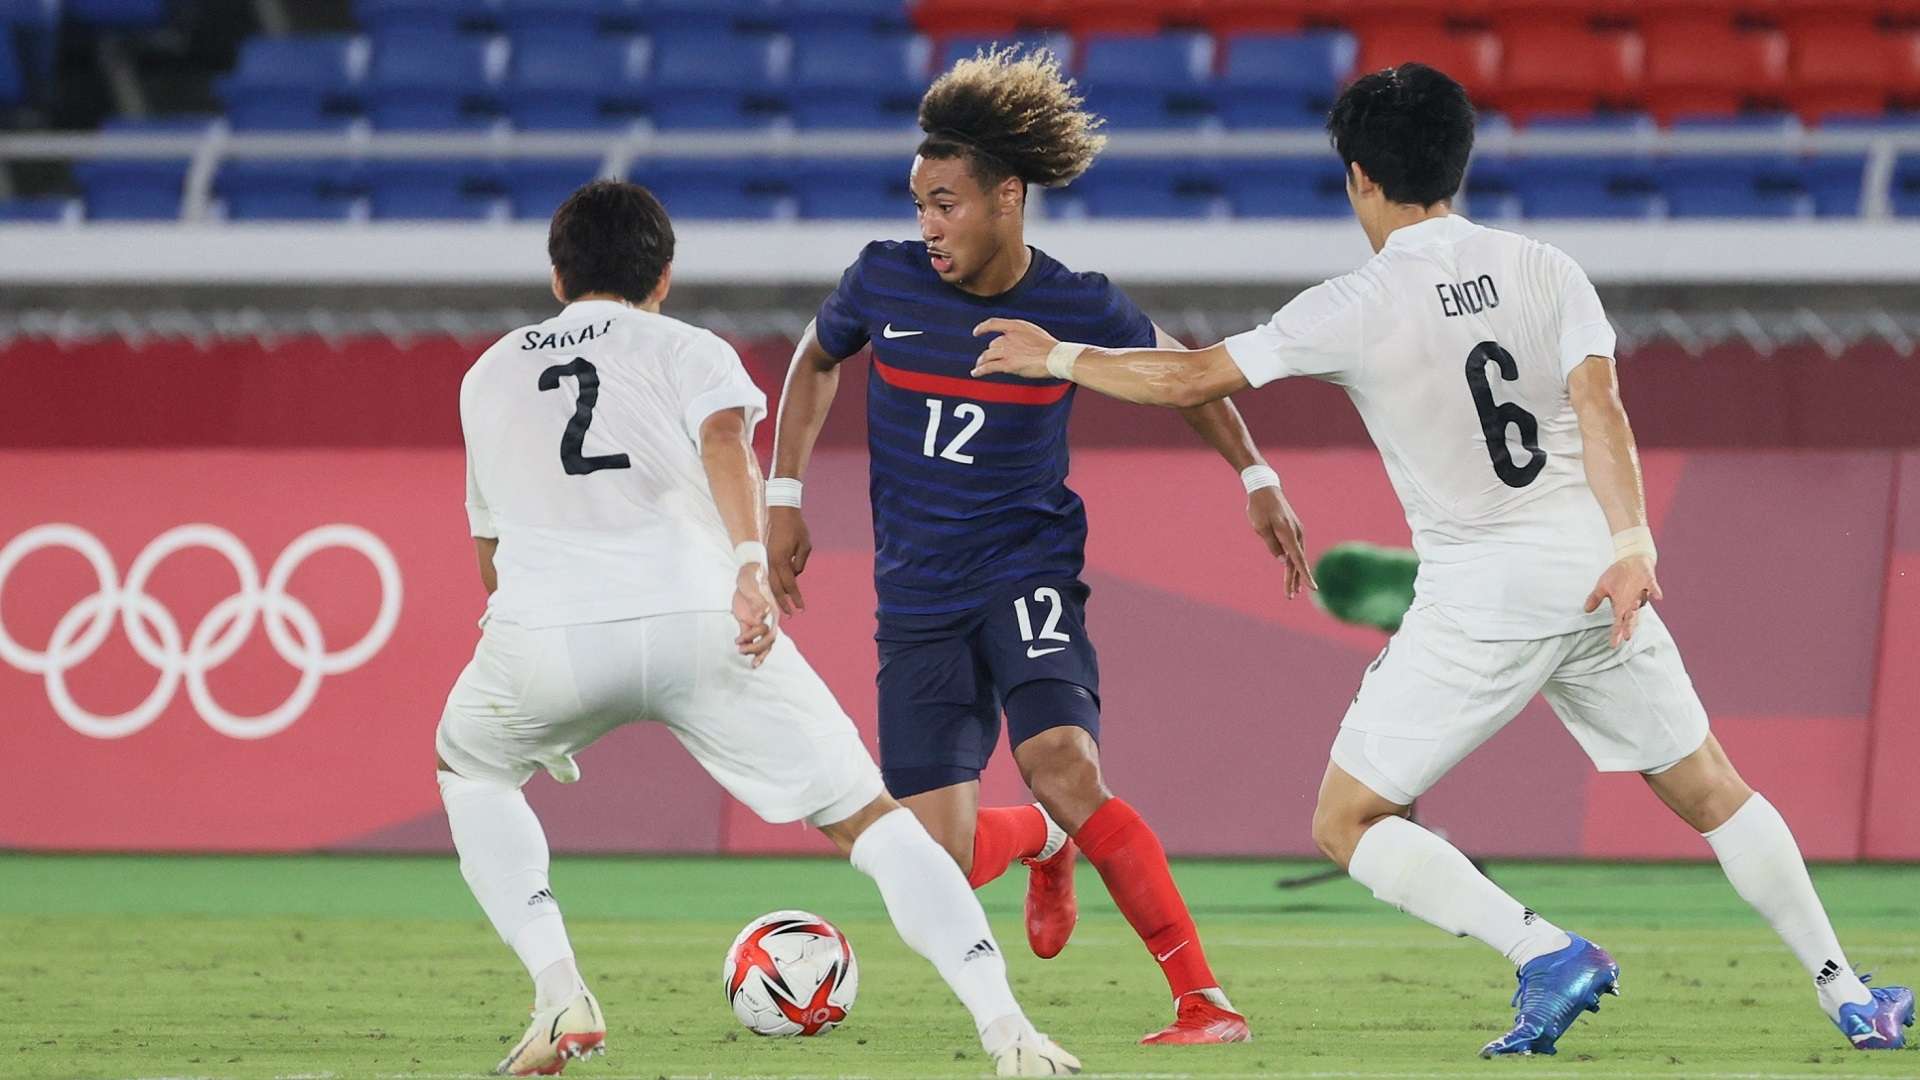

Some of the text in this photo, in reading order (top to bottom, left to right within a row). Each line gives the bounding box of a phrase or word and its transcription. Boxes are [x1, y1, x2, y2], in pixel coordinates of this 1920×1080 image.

[1435, 274, 1499, 317] ENDO
[538, 357, 631, 475] 2
[923, 398, 986, 464] 12
[1465, 340, 1547, 488] 6
[1014, 587, 1070, 642] 12
